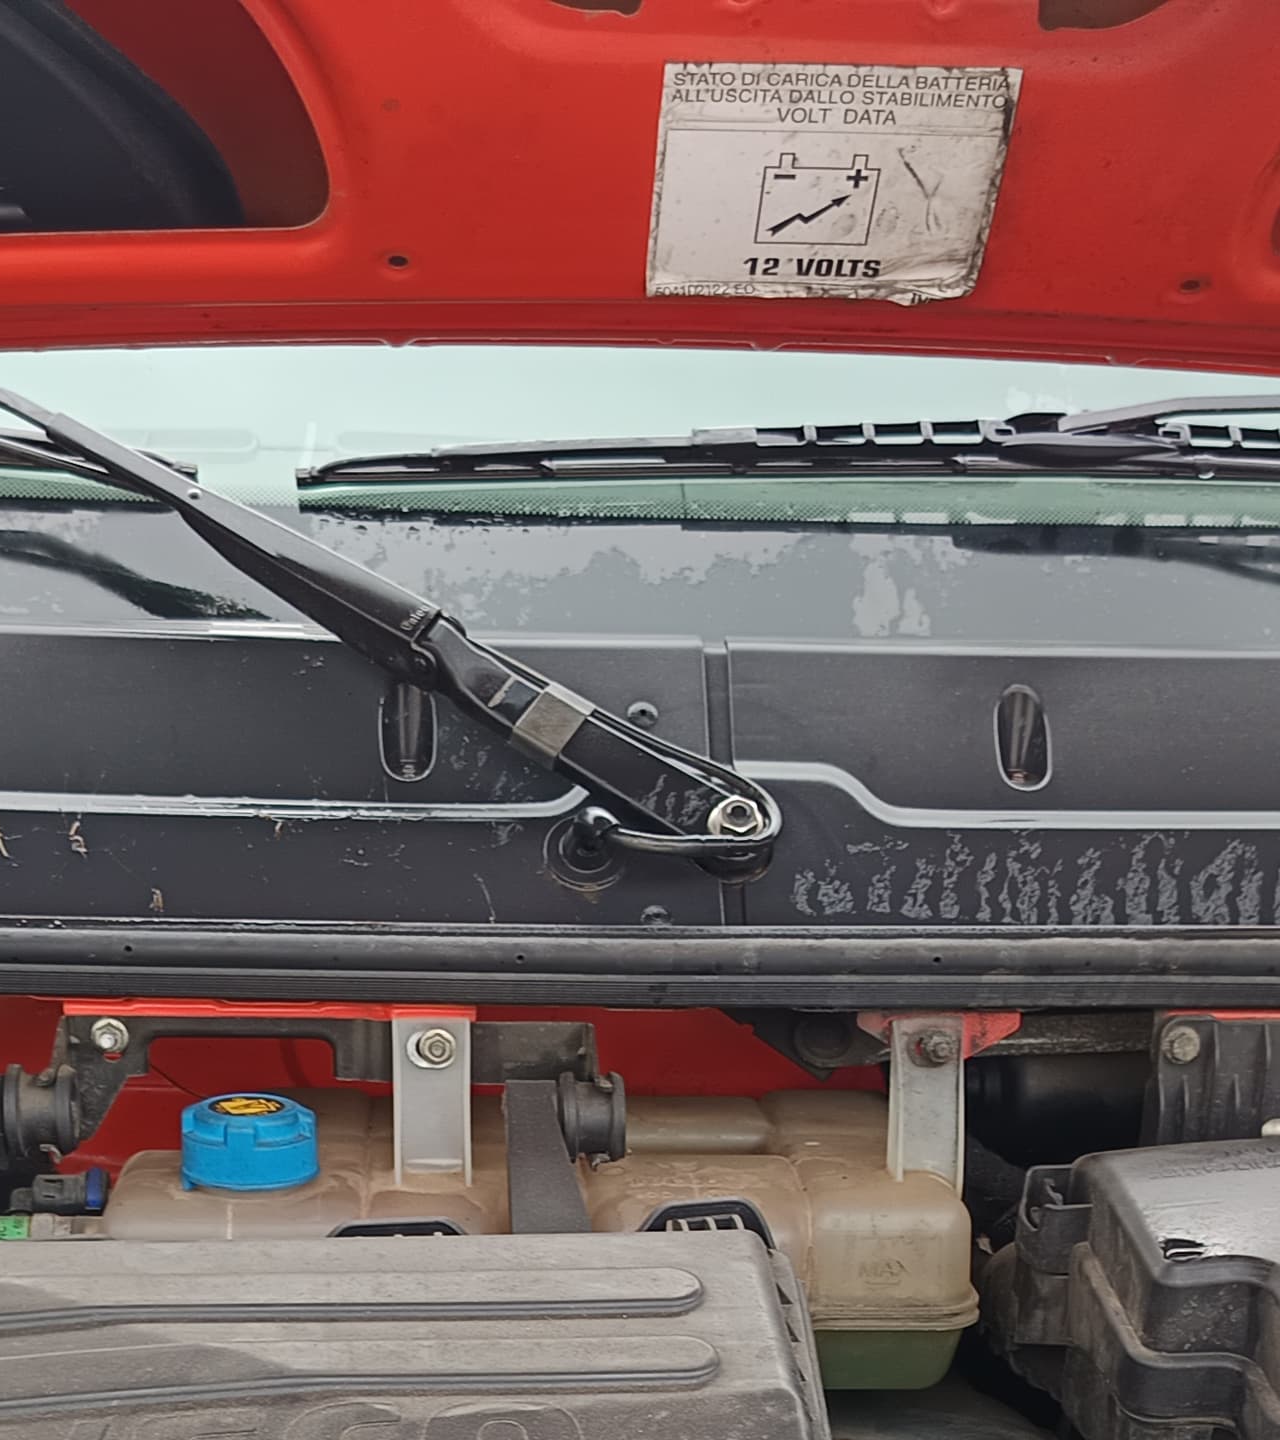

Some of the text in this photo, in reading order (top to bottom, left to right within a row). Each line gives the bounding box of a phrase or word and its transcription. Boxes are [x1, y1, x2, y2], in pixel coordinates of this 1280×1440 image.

[673, 72, 1010, 91] STATO DI CARICA DELLA BATTERIA
[672, 88, 1008, 109] ALL'USCITA DALLO STABILIMENTO
[777, 107, 897, 125] VOLT DATA
[743, 257, 881, 278] 12 VOLTS
